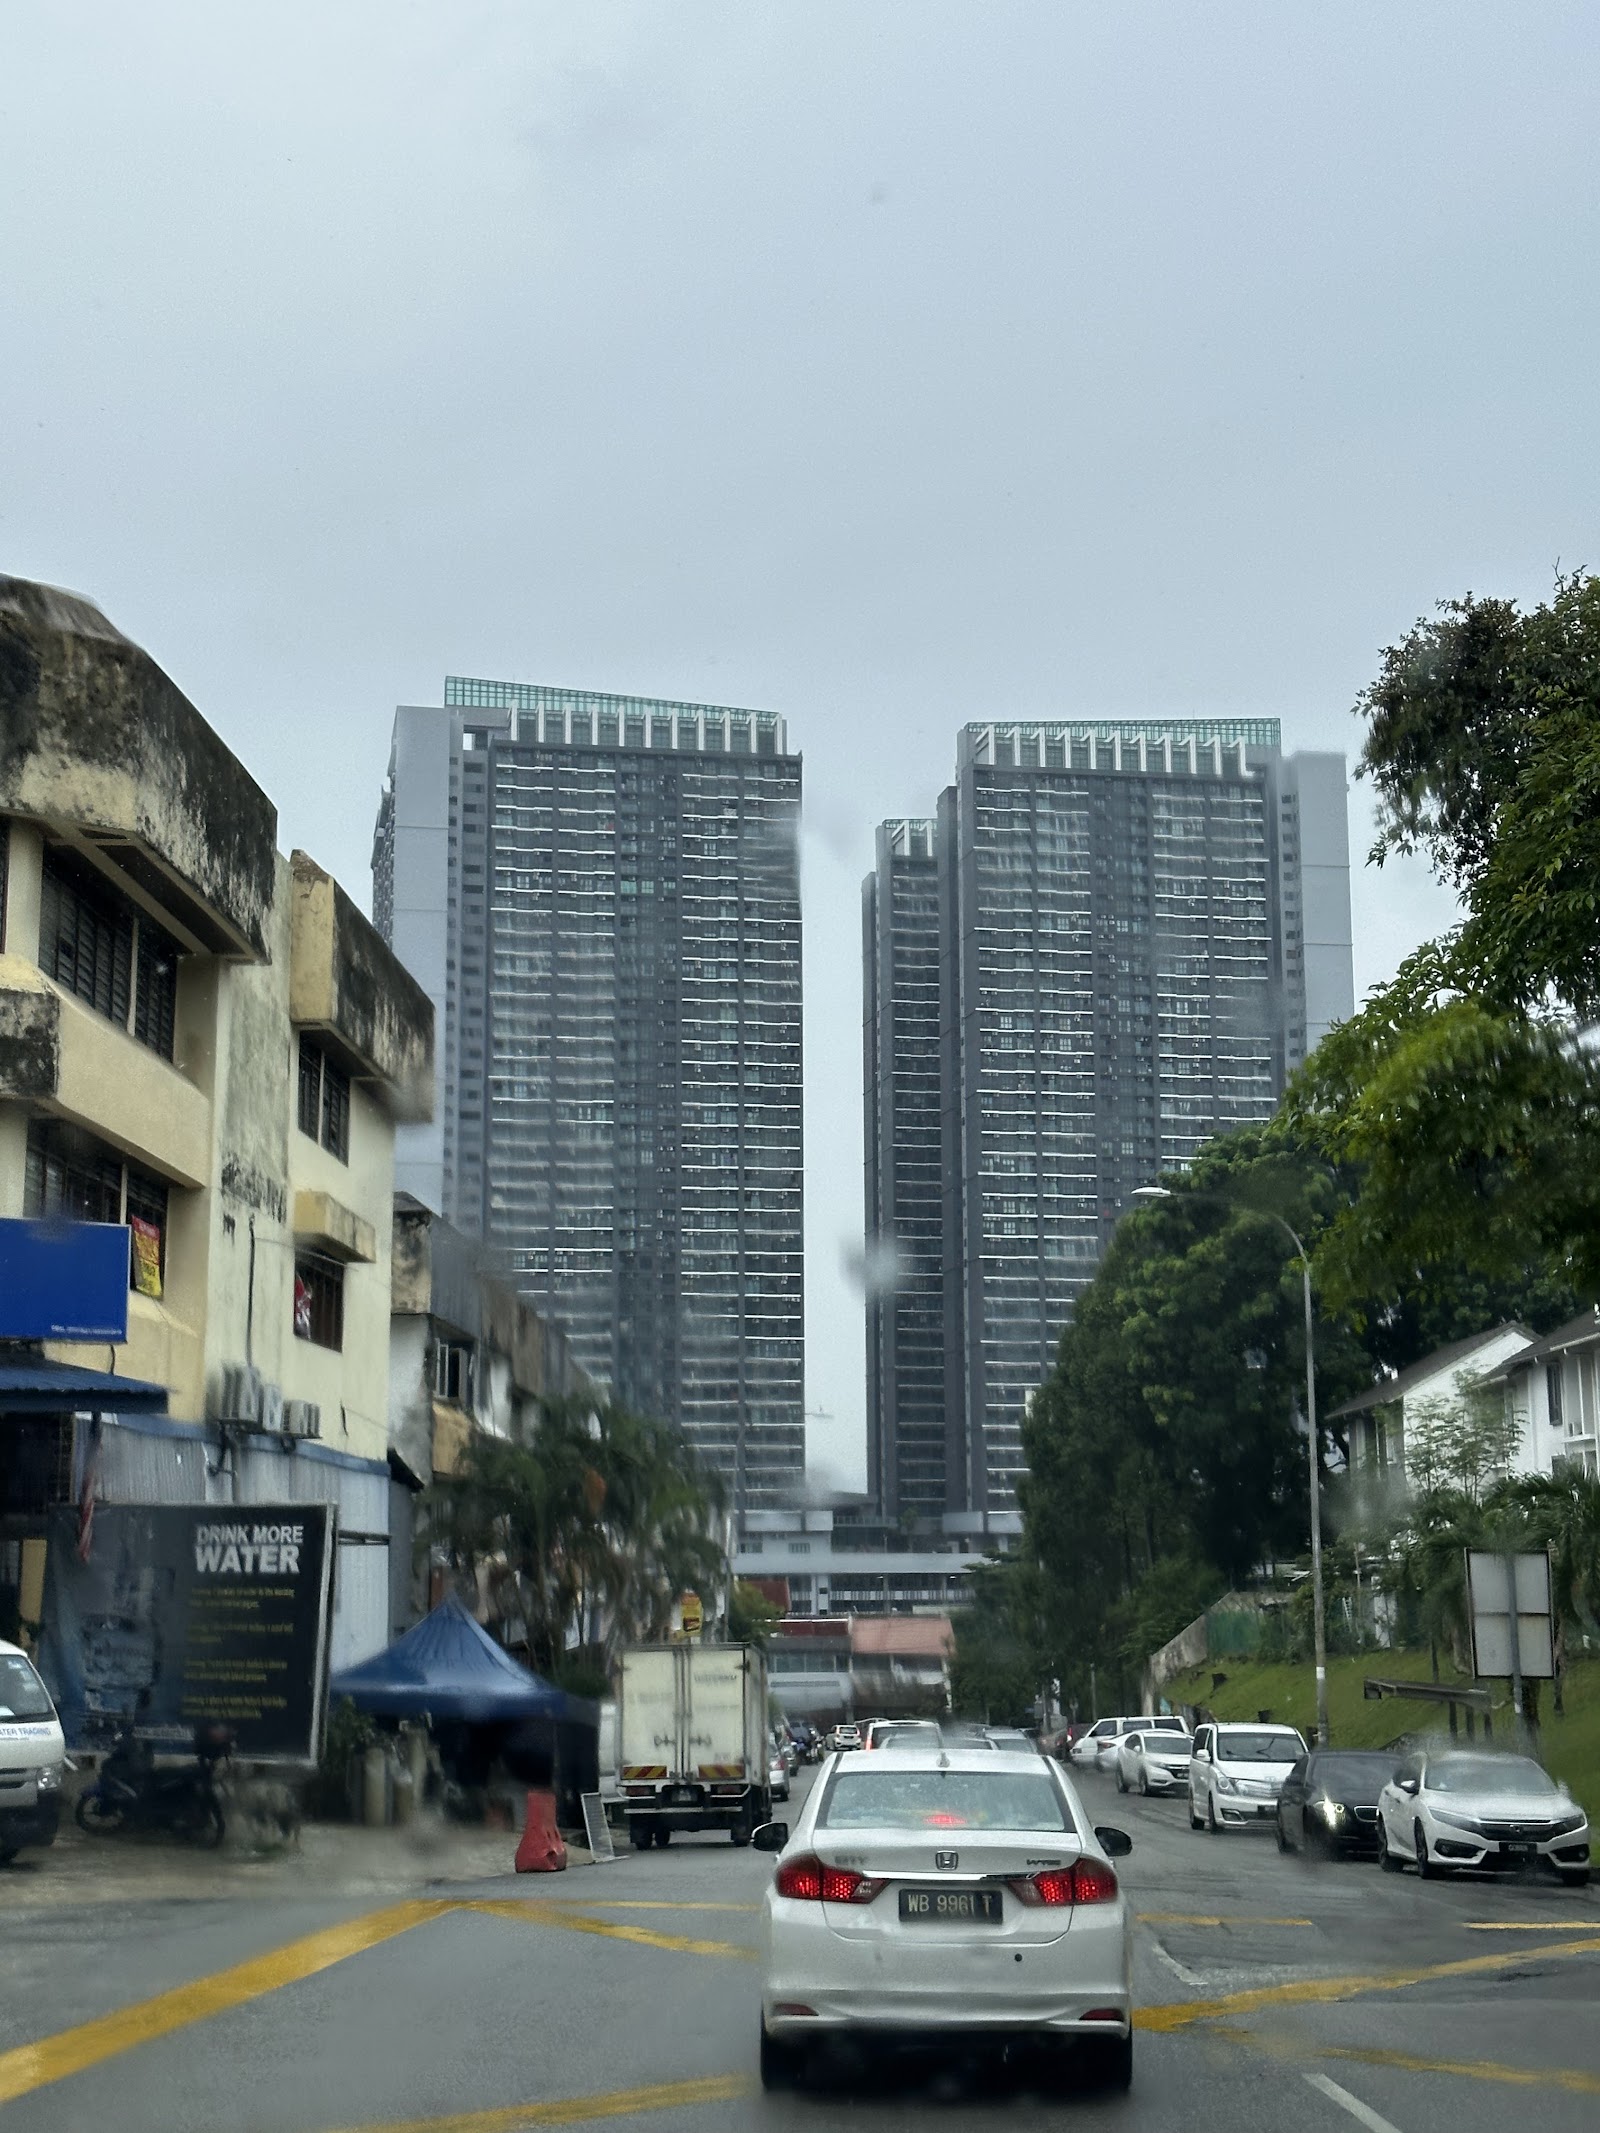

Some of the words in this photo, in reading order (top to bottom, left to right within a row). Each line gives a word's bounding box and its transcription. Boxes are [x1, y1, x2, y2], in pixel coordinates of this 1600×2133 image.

[197, 1525, 249, 1544] DRINK
[253, 1525, 305, 1544] MORE
[195, 1544, 300, 1574] WATER
[908, 1894, 930, 1913] WB
[937, 1894, 975, 1915] 9961
[982, 1895, 992, 1915] T
